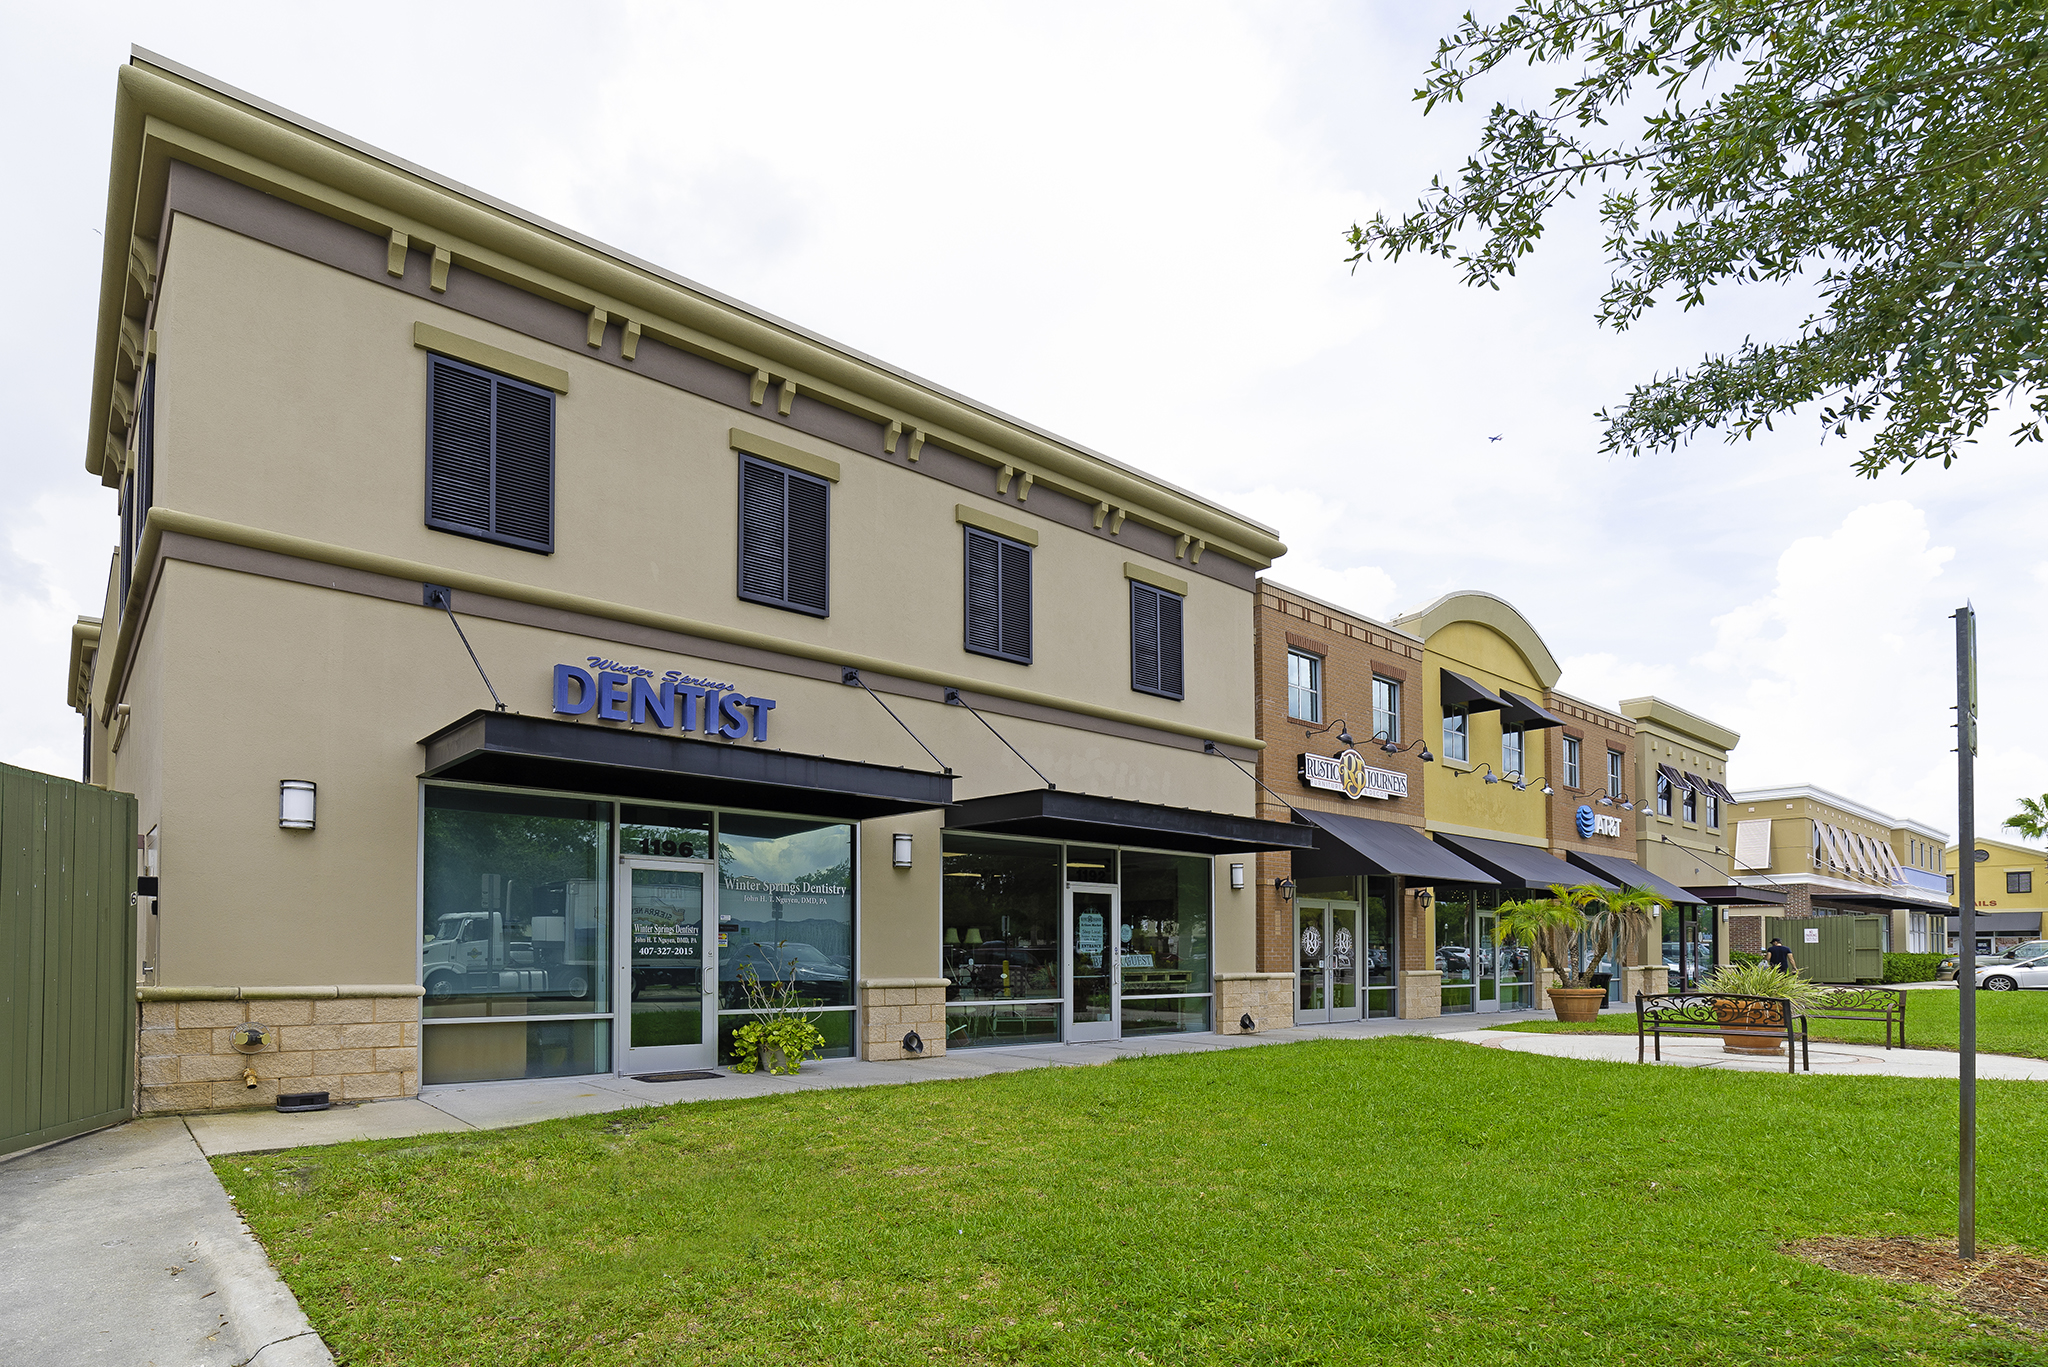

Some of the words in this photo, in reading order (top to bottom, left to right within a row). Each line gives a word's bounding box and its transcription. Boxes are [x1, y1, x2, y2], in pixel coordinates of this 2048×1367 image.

[587, 656, 654, 678] Winter
[661, 670, 735, 692] Springs
[553, 663, 776, 743] DENTIST
[1306, 758, 1339, 781] RUSTIC
[1366, 770, 1407, 793] JOURNEYS
[1595, 814, 1622, 838] AT&T
[639, 839, 694, 857] 1196
[1077, 870, 1106, 881] 1192
[657, 887, 685, 899] OPEN
[724, 878, 761, 891] Winter
[762, 880, 801, 896] Springs
[802, 882, 847, 898] Dentistry
[775, 896, 800, 905] Nguyen,
[801, 897, 818, 905] DMD,
[634, 924, 653, 933] Winter
[654, 924, 675, 935] Springs
[675, 925, 699, 936] Dentistry
[638, 947, 694, 956] 407-327-2015
